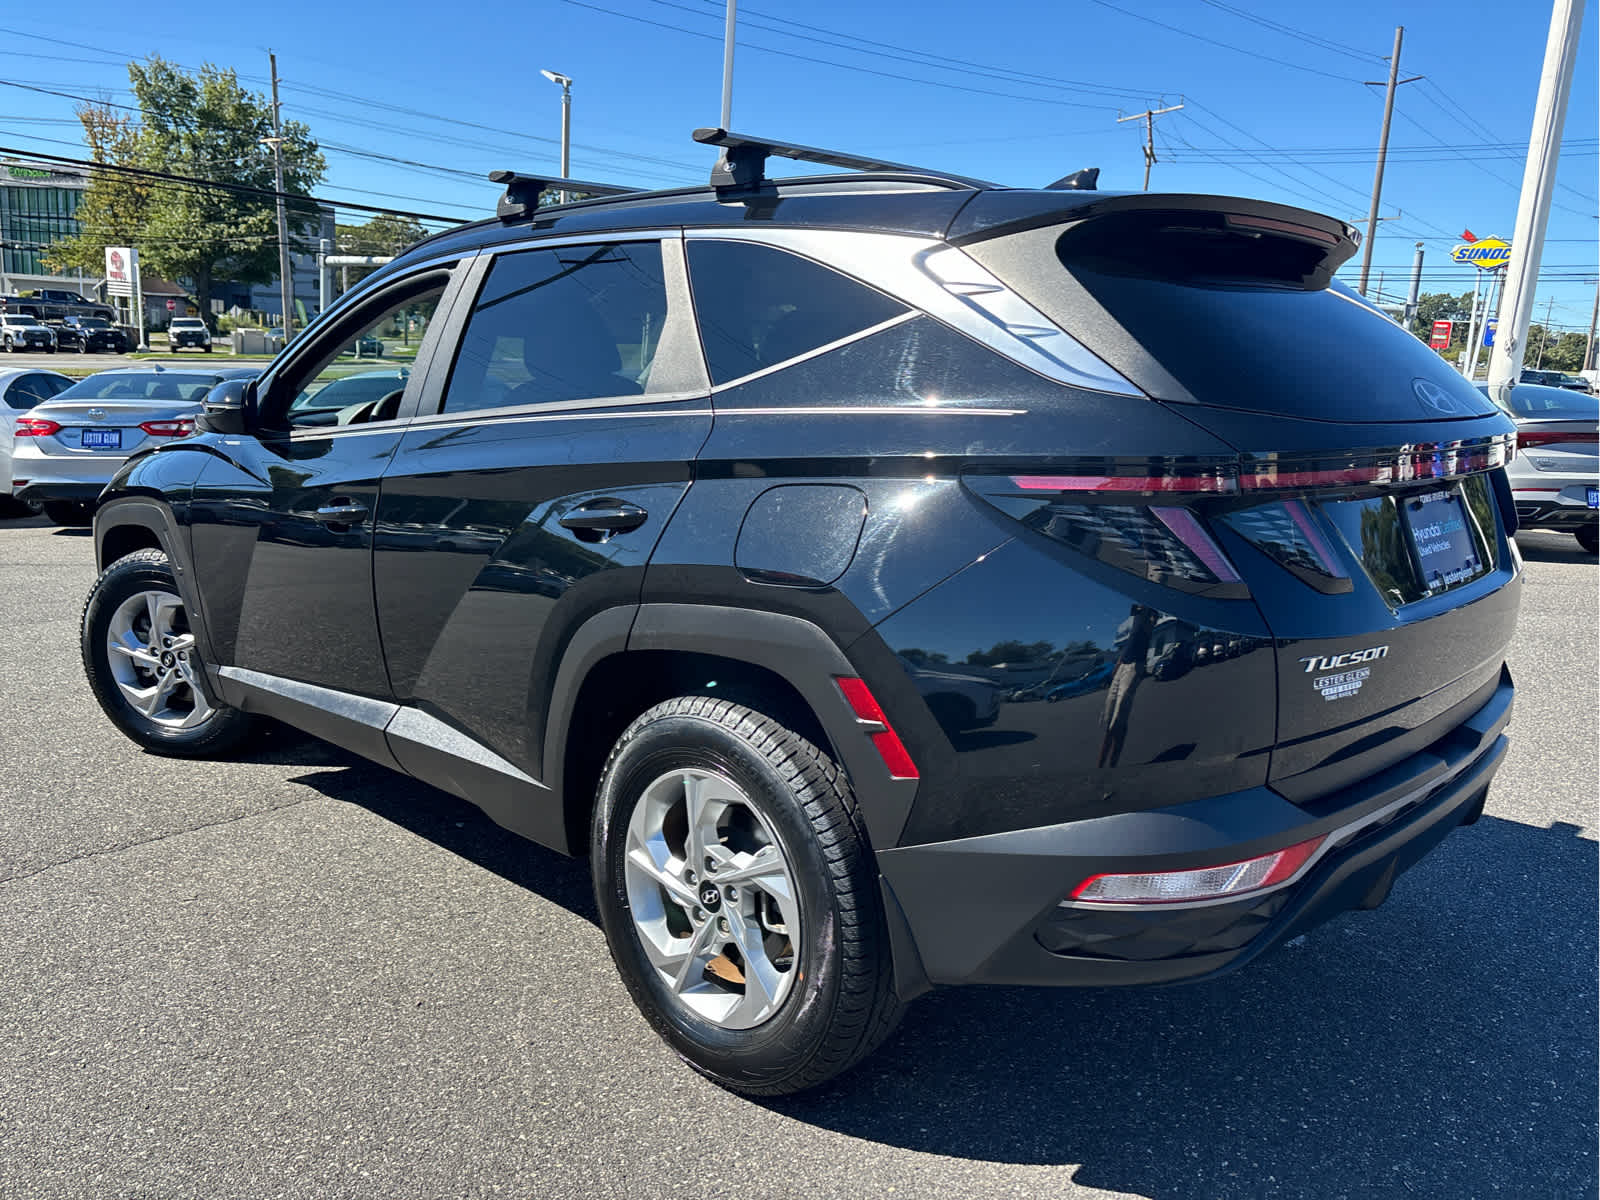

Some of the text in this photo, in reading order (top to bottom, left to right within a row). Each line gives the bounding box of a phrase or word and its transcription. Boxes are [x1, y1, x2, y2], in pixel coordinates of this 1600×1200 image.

[1455, 247, 1512, 260] SUNOC
[1313, 669, 1370, 688] LESTER GLENN
